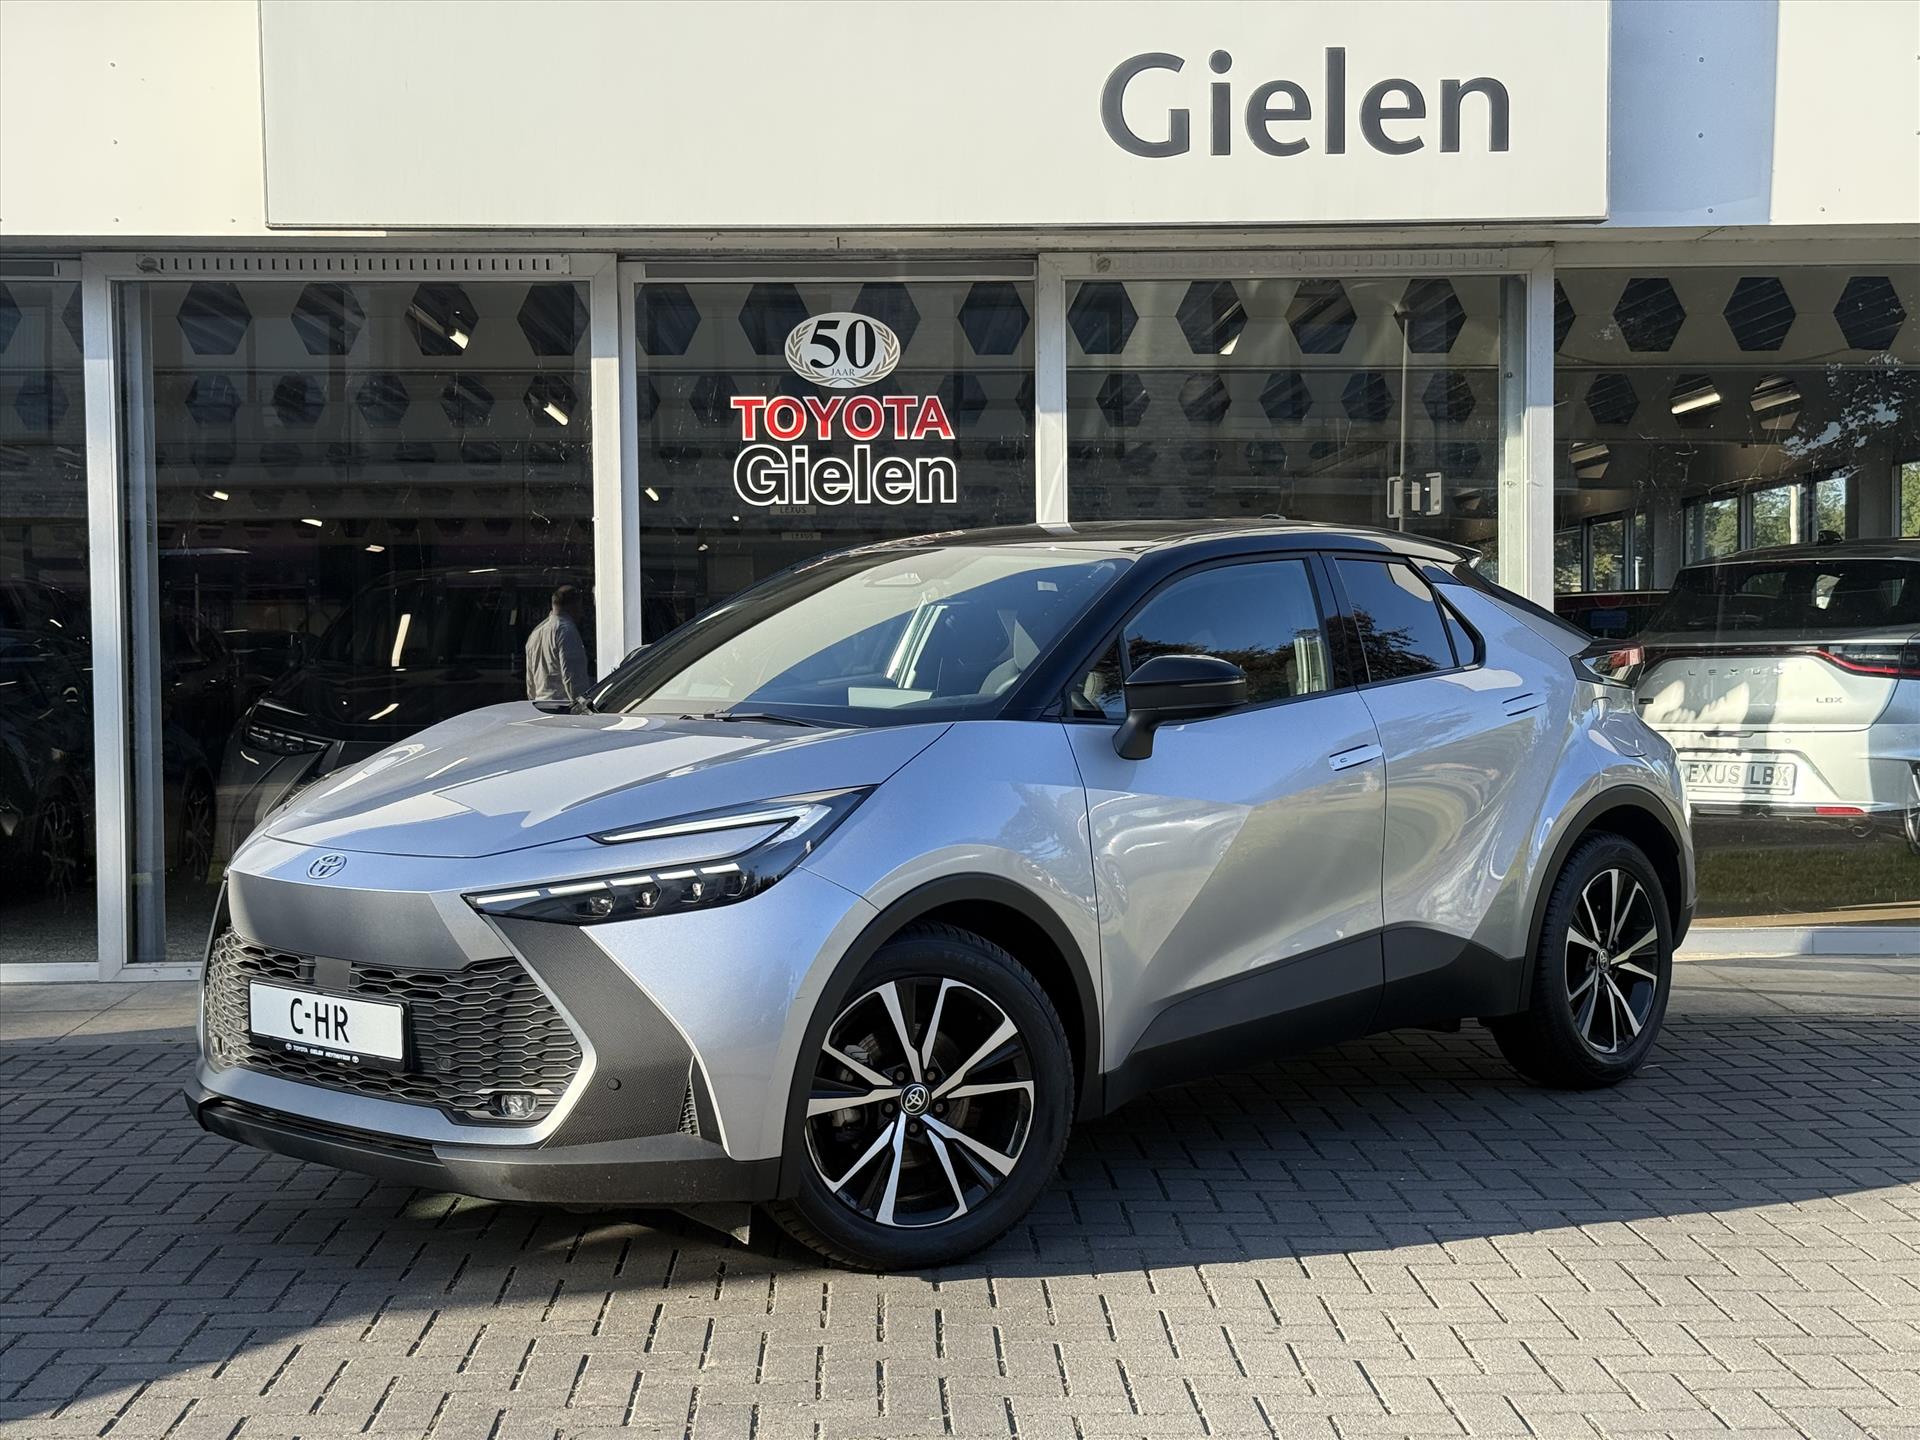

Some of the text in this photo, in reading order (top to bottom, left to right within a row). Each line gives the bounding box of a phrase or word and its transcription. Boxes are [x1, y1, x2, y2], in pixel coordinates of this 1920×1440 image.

[1101, 47, 1509, 158] Gielen
[810, 319, 876, 369] 50
[830, 368, 856, 377] JAAR
[730, 395, 956, 441] TOYOTA
[733, 444, 957, 506] Gielen
[779, 506, 808, 514] LEXUS
[1687, 667, 1784, 676] LEXUS
[1815, 696, 1844, 704] LBX
[1686, 763, 1790, 786] EXUS LBX
[290, 998, 350, 1043] C-HR
